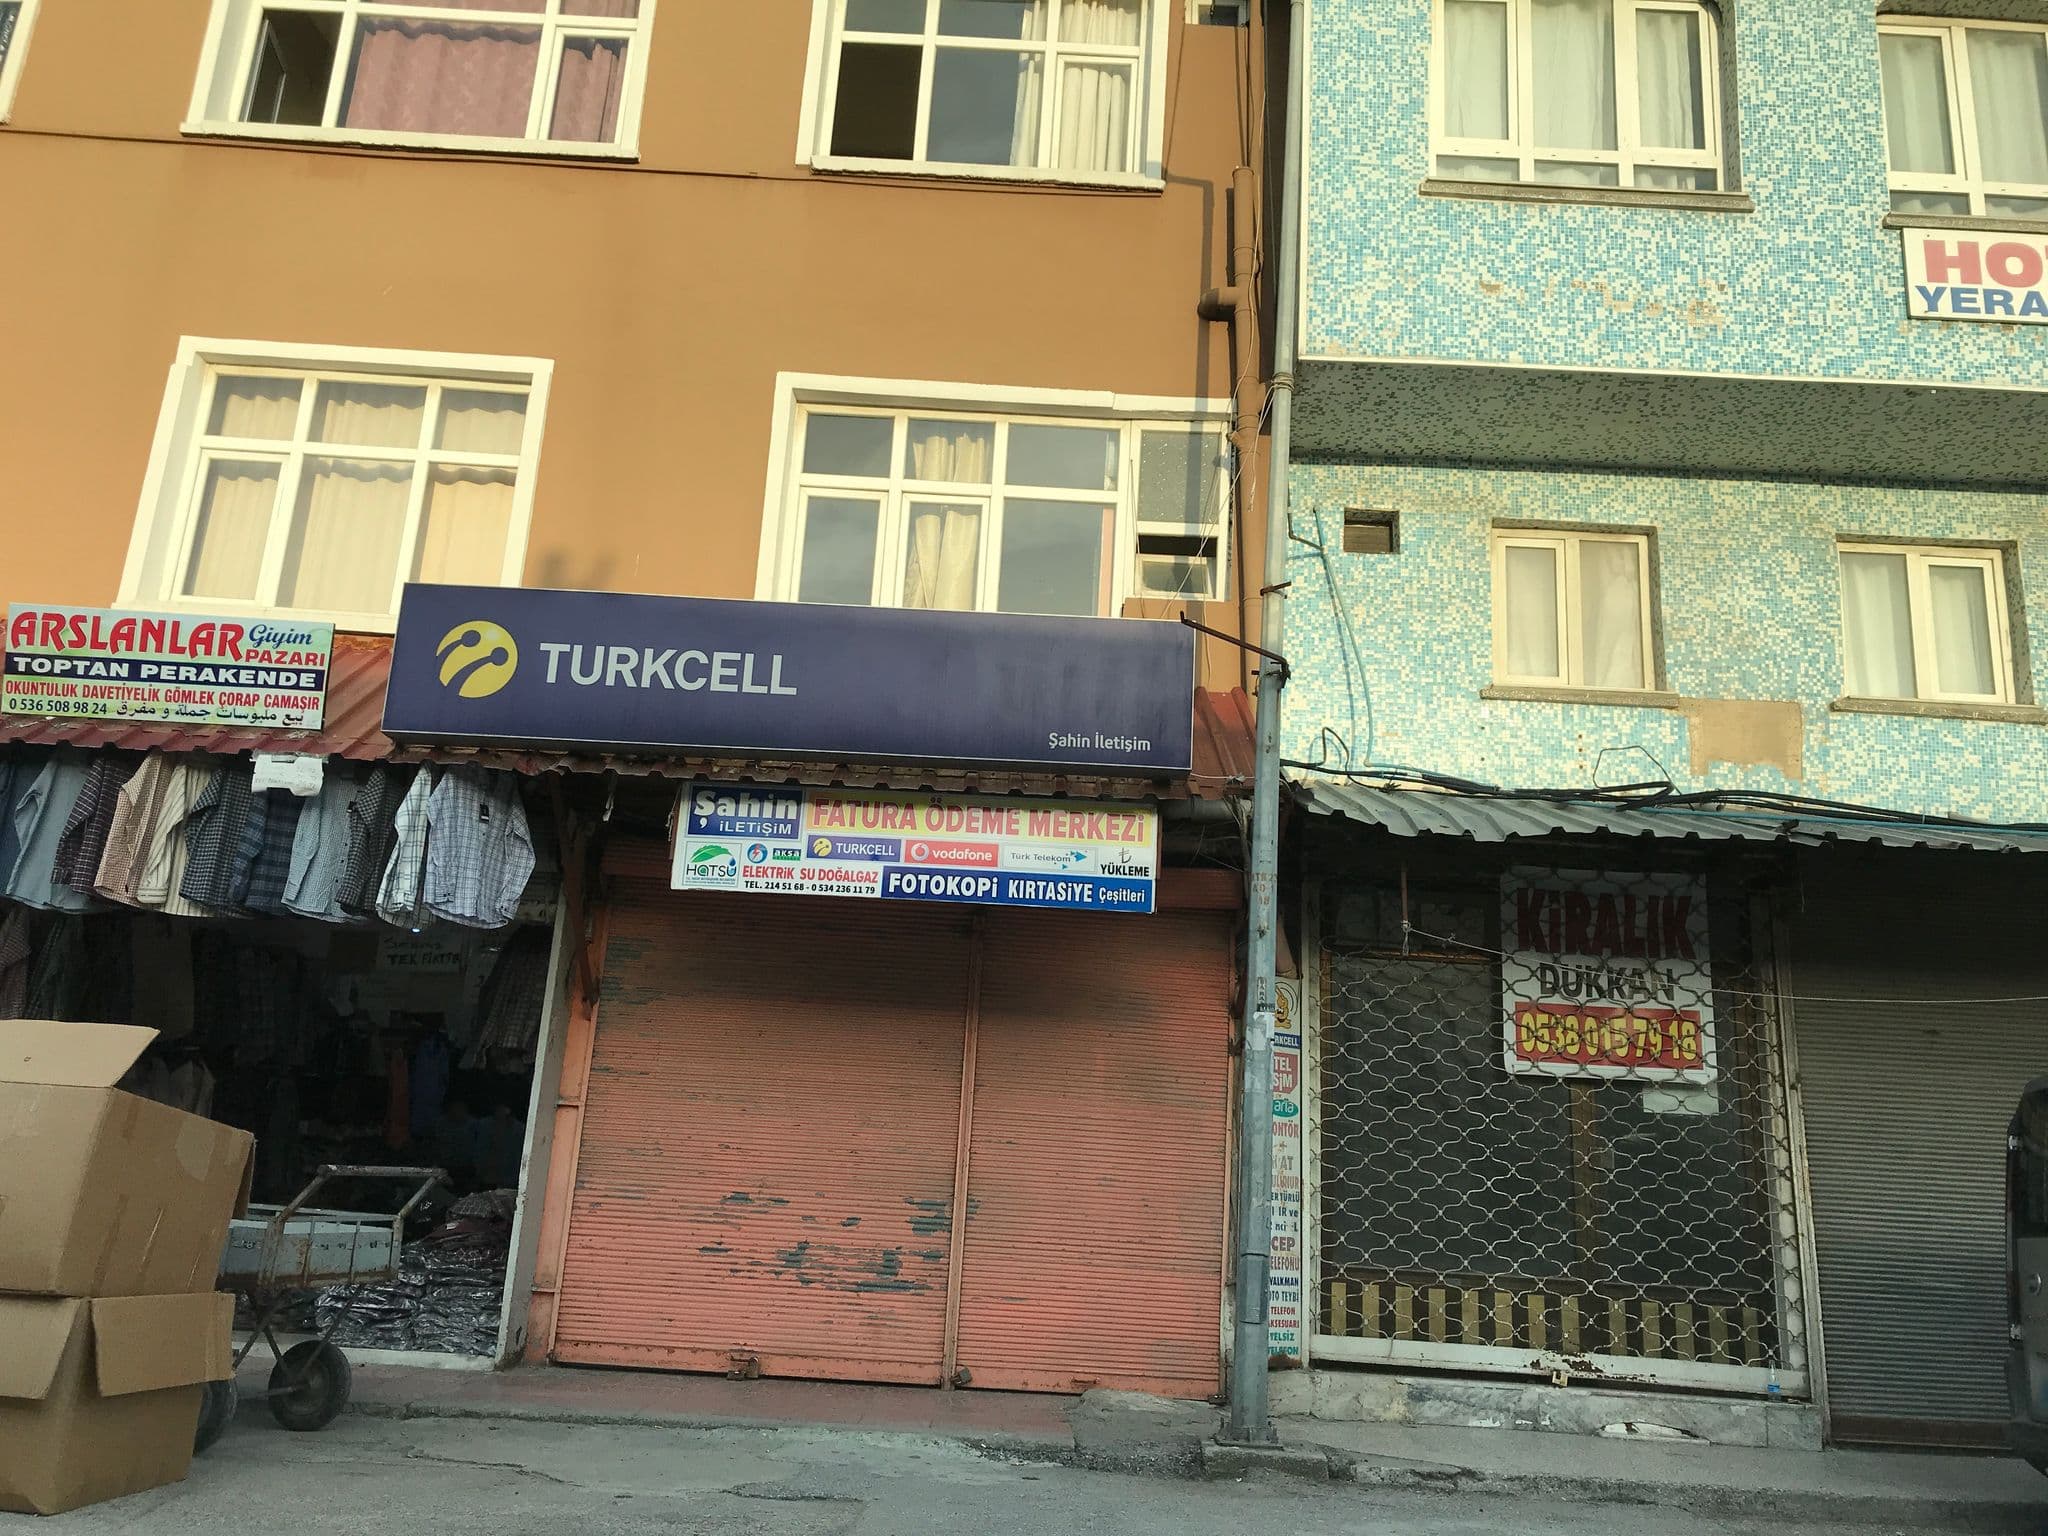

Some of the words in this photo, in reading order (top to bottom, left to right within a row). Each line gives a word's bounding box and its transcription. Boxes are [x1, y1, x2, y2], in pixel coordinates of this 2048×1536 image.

[1923, 240, 2048, 288] HO
[11, 612, 244, 662] ARSLANLAR
[249, 624, 313, 648] Giyim
[245, 648, 325, 667] PAZARI
[13, 656, 130, 678] TOPTAN
[140, 663, 317, 688] PERAKENDE
[539, 642, 798, 696] TURKCELL
[5, 680, 78, 698] OKUNTULUK
[164, 688, 215, 706] GÖMLEK
[218, 691, 260, 709] ÇORAP
[9, 698, 17, 710] 0
[19, 699, 43, 712] 536
[46, 701, 70, 714] 508
[73, 703, 89, 714] 98
[91, 702, 107, 715] 24
[1048, 732, 1091, 750] Şahin
[1094, 731, 1151, 753] İletişim
[694, 790, 798, 829] Şahin
[813, 799, 917, 832] FATURA
[925, 796, 1020, 836] ÖDEME
[836, 842, 895, 857] TURKCELL
[932, 848, 993, 862] vodafone
[1011, 851, 1031, 861] Türk
[1034, 853, 1071, 864] Telekom
[800, 868, 816, 881] SU
[818, 866, 879, 884] DOĞALGAZ
[1100, 862, 1150, 878] YÜKLEME
[745, 880, 763, 889] TEL.
[765, 881, 780, 891] 214
[782, 882, 792, 892] 51
[819, 884, 834, 893] 534
[836, 884, 851, 894] 236
[853, 886, 863, 895] 11
[865, 887, 876, 896] 79
[1099, 887, 1146, 905] Çeşitleri
[1271, 1235, 1296, 1252] CEP
